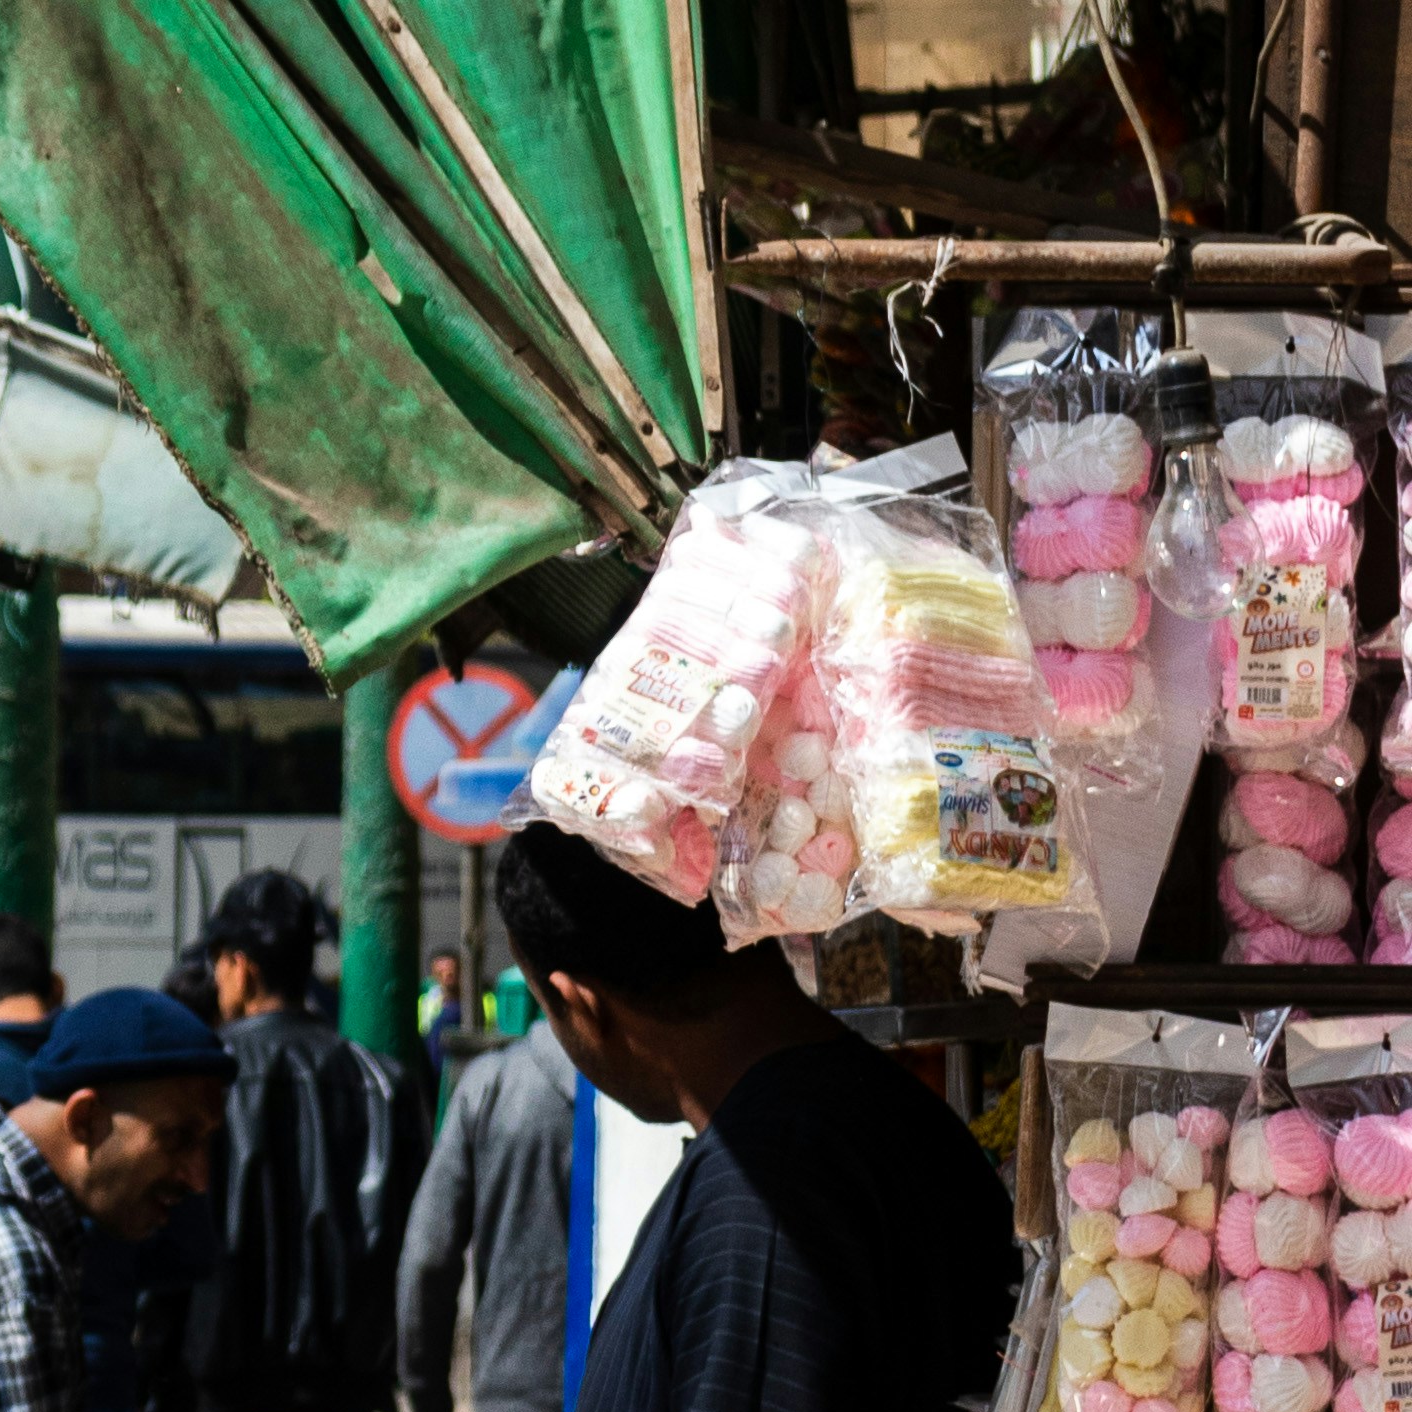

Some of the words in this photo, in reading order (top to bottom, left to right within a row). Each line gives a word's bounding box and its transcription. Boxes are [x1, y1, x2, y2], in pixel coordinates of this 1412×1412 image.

[1242, 611, 1299, 637] MOVE
[1250, 627, 1320, 654] MENTS
[945, 827, 1052, 867] CANDY
